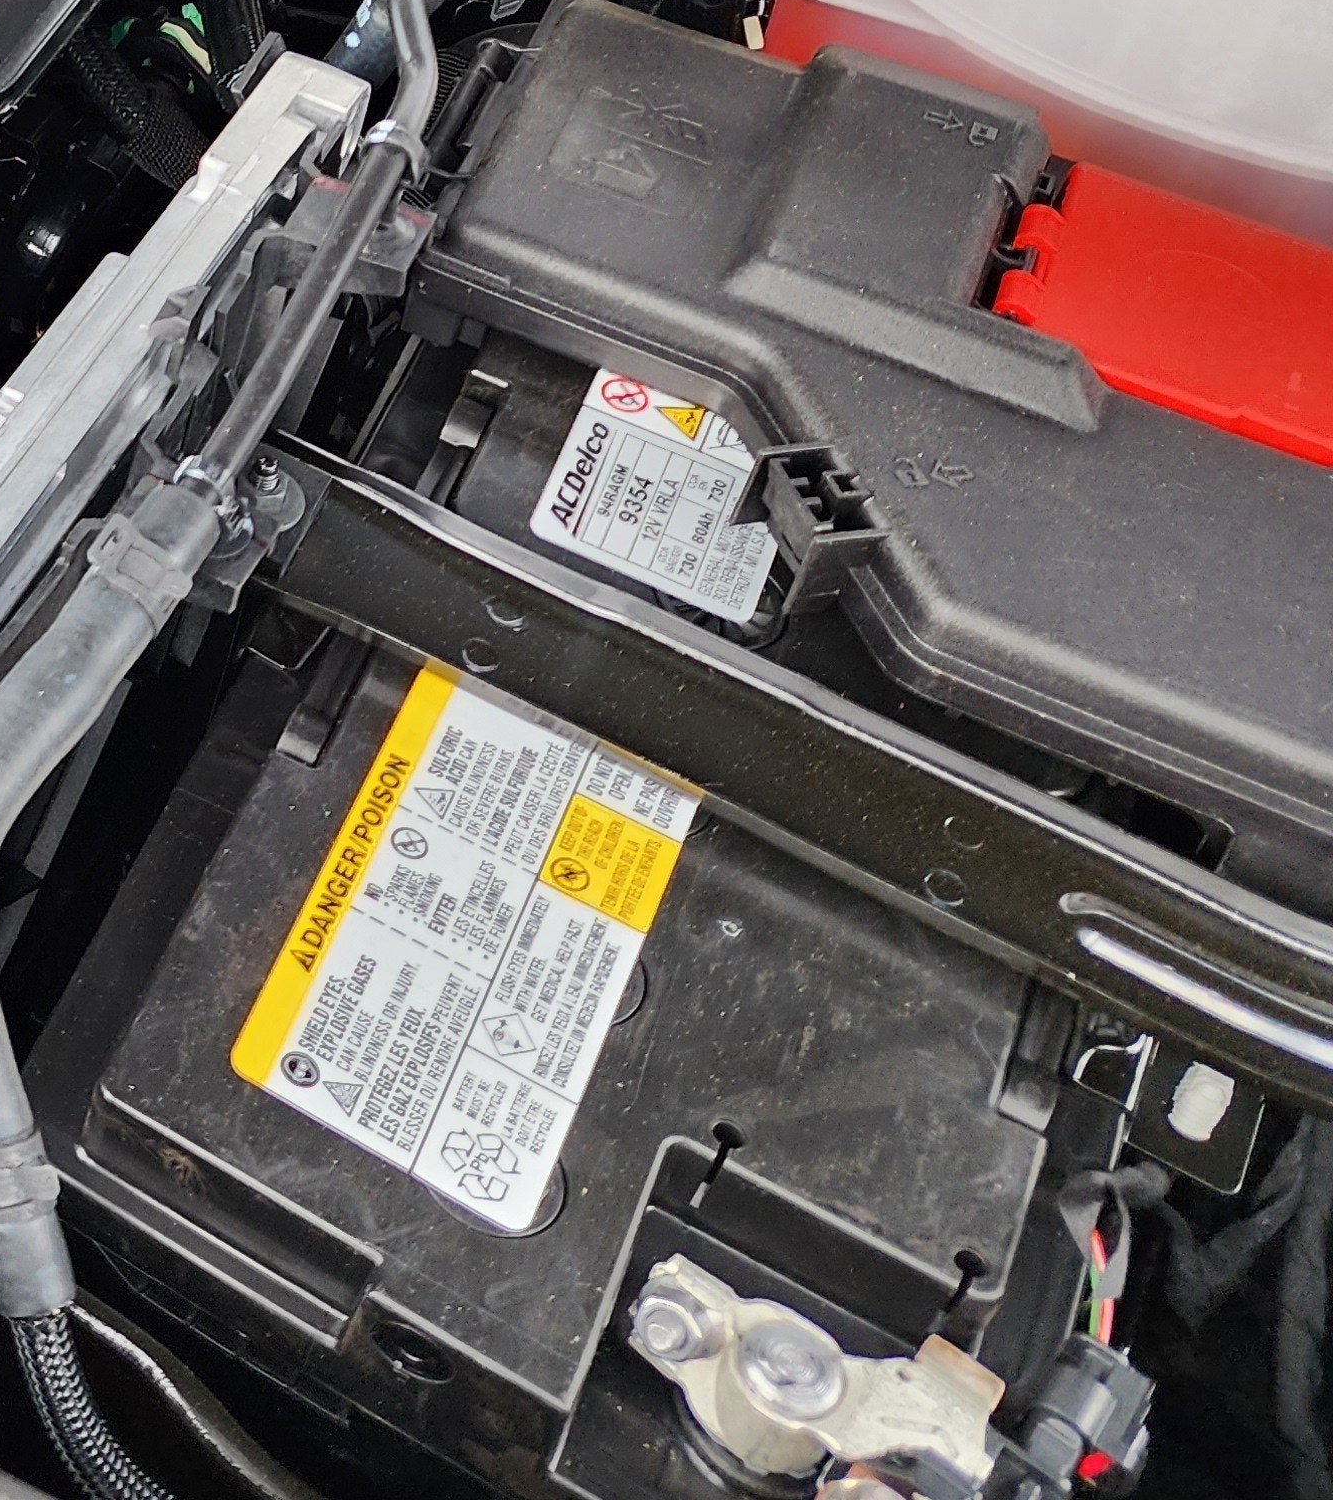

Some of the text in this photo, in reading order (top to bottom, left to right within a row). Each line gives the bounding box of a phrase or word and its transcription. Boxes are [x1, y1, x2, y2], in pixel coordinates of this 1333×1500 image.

[546, 417, 610, 528] ACDelco
[595, 462, 628, 518] 94RAGM
[709, 477, 727, 504] 730
[617, 472, 654, 526] 9354
[652, 475, 679, 517] VRLA
[642, 515, 663, 543] 12V
[679, 551, 698, 579] 730
[696, 551, 725, 597] GENERAL
[712, 521, 754, 603] 300 RENAISSANCE
[727, 566, 754, 610] DETROIT,
[743, 553, 758, 568] MI
[426, 724, 465, 779] SULFURIC
[444, 737, 479, 787] ACID CAN
[447, 740, 498, 829] CAUSE BLINDNESS
[471, 781, 500, 822] SEVERE
[481, 745, 540, 847] L'ACIDE SULFURIQUE
[532, 774, 550, 792] LA
[585, 775, 608, 797] DO
[464, 818, 483, 837] OR
[514, 788, 544, 831] CAUSER
[557, 802, 589, 853] KEEP OUT OF
[632, 797, 653, 818] NE
[298, 752, 412, 951] DANGER/POISON
[503, 826, 527, 857] PEUT
[520, 847, 539, 866] OU
[527, 826, 548, 850] DES
[575, 816, 604, 862] THE REACH
[383, 863, 412, 903] SPARKS
[593, 855, 610, 871] OF
[599, 838, 641, 912] TENIR HORS DE LA
[630, 873, 647, 890] DE
[363, 881, 384, 902] NO
[397, 869, 426, 910] FLAMES
[412, 871, 443, 918] SMOKING
[466, 875, 508, 947] LES FLAMMES
[450, 915, 471, 939] LES
[482, 901, 515, 955] DE FUMER
[494, 894, 551, 1004] FLUSH EYES IMMEDIATELY
[554, 939, 575, 966] HELP
[511, 985, 534, 1014] WITH
[537, 962, 566, 1005] MEDICAL
[296, 970, 348, 1053] SHIELD EYES.
[314, 952, 377, 1063] EXPLOSIVE GASES
[353, 957, 420, 1083] BLINDNESS OR INJURY.
[396, 1000, 426, 1041] YEUX.
[530, 1001, 550, 1024] GET
[335, 1008, 375, 1073] CAN CAUSE
[377, 971, 464, 1143] LES GAZ EXPLOSIFS PEUVENT
[385, 1038, 410, 1066] LES
[426, 1033, 458, 1082] RENDRE
[544, 1029, 563, 1049] LES
[419, 1078, 439, 1100] OU
[451, 1069, 477, 1112] BATTERY
[465, 1078, 491, 1120] MUST BE
[480, 1079, 508, 1128] RECYCLED
[500, 1081, 532, 1140] LA BATTERIE
[396, 1097, 431, 1153] BLESSER
[514, 1121, 533, 1148] DOIT
[469, 1149, 490, 1174] Pb
